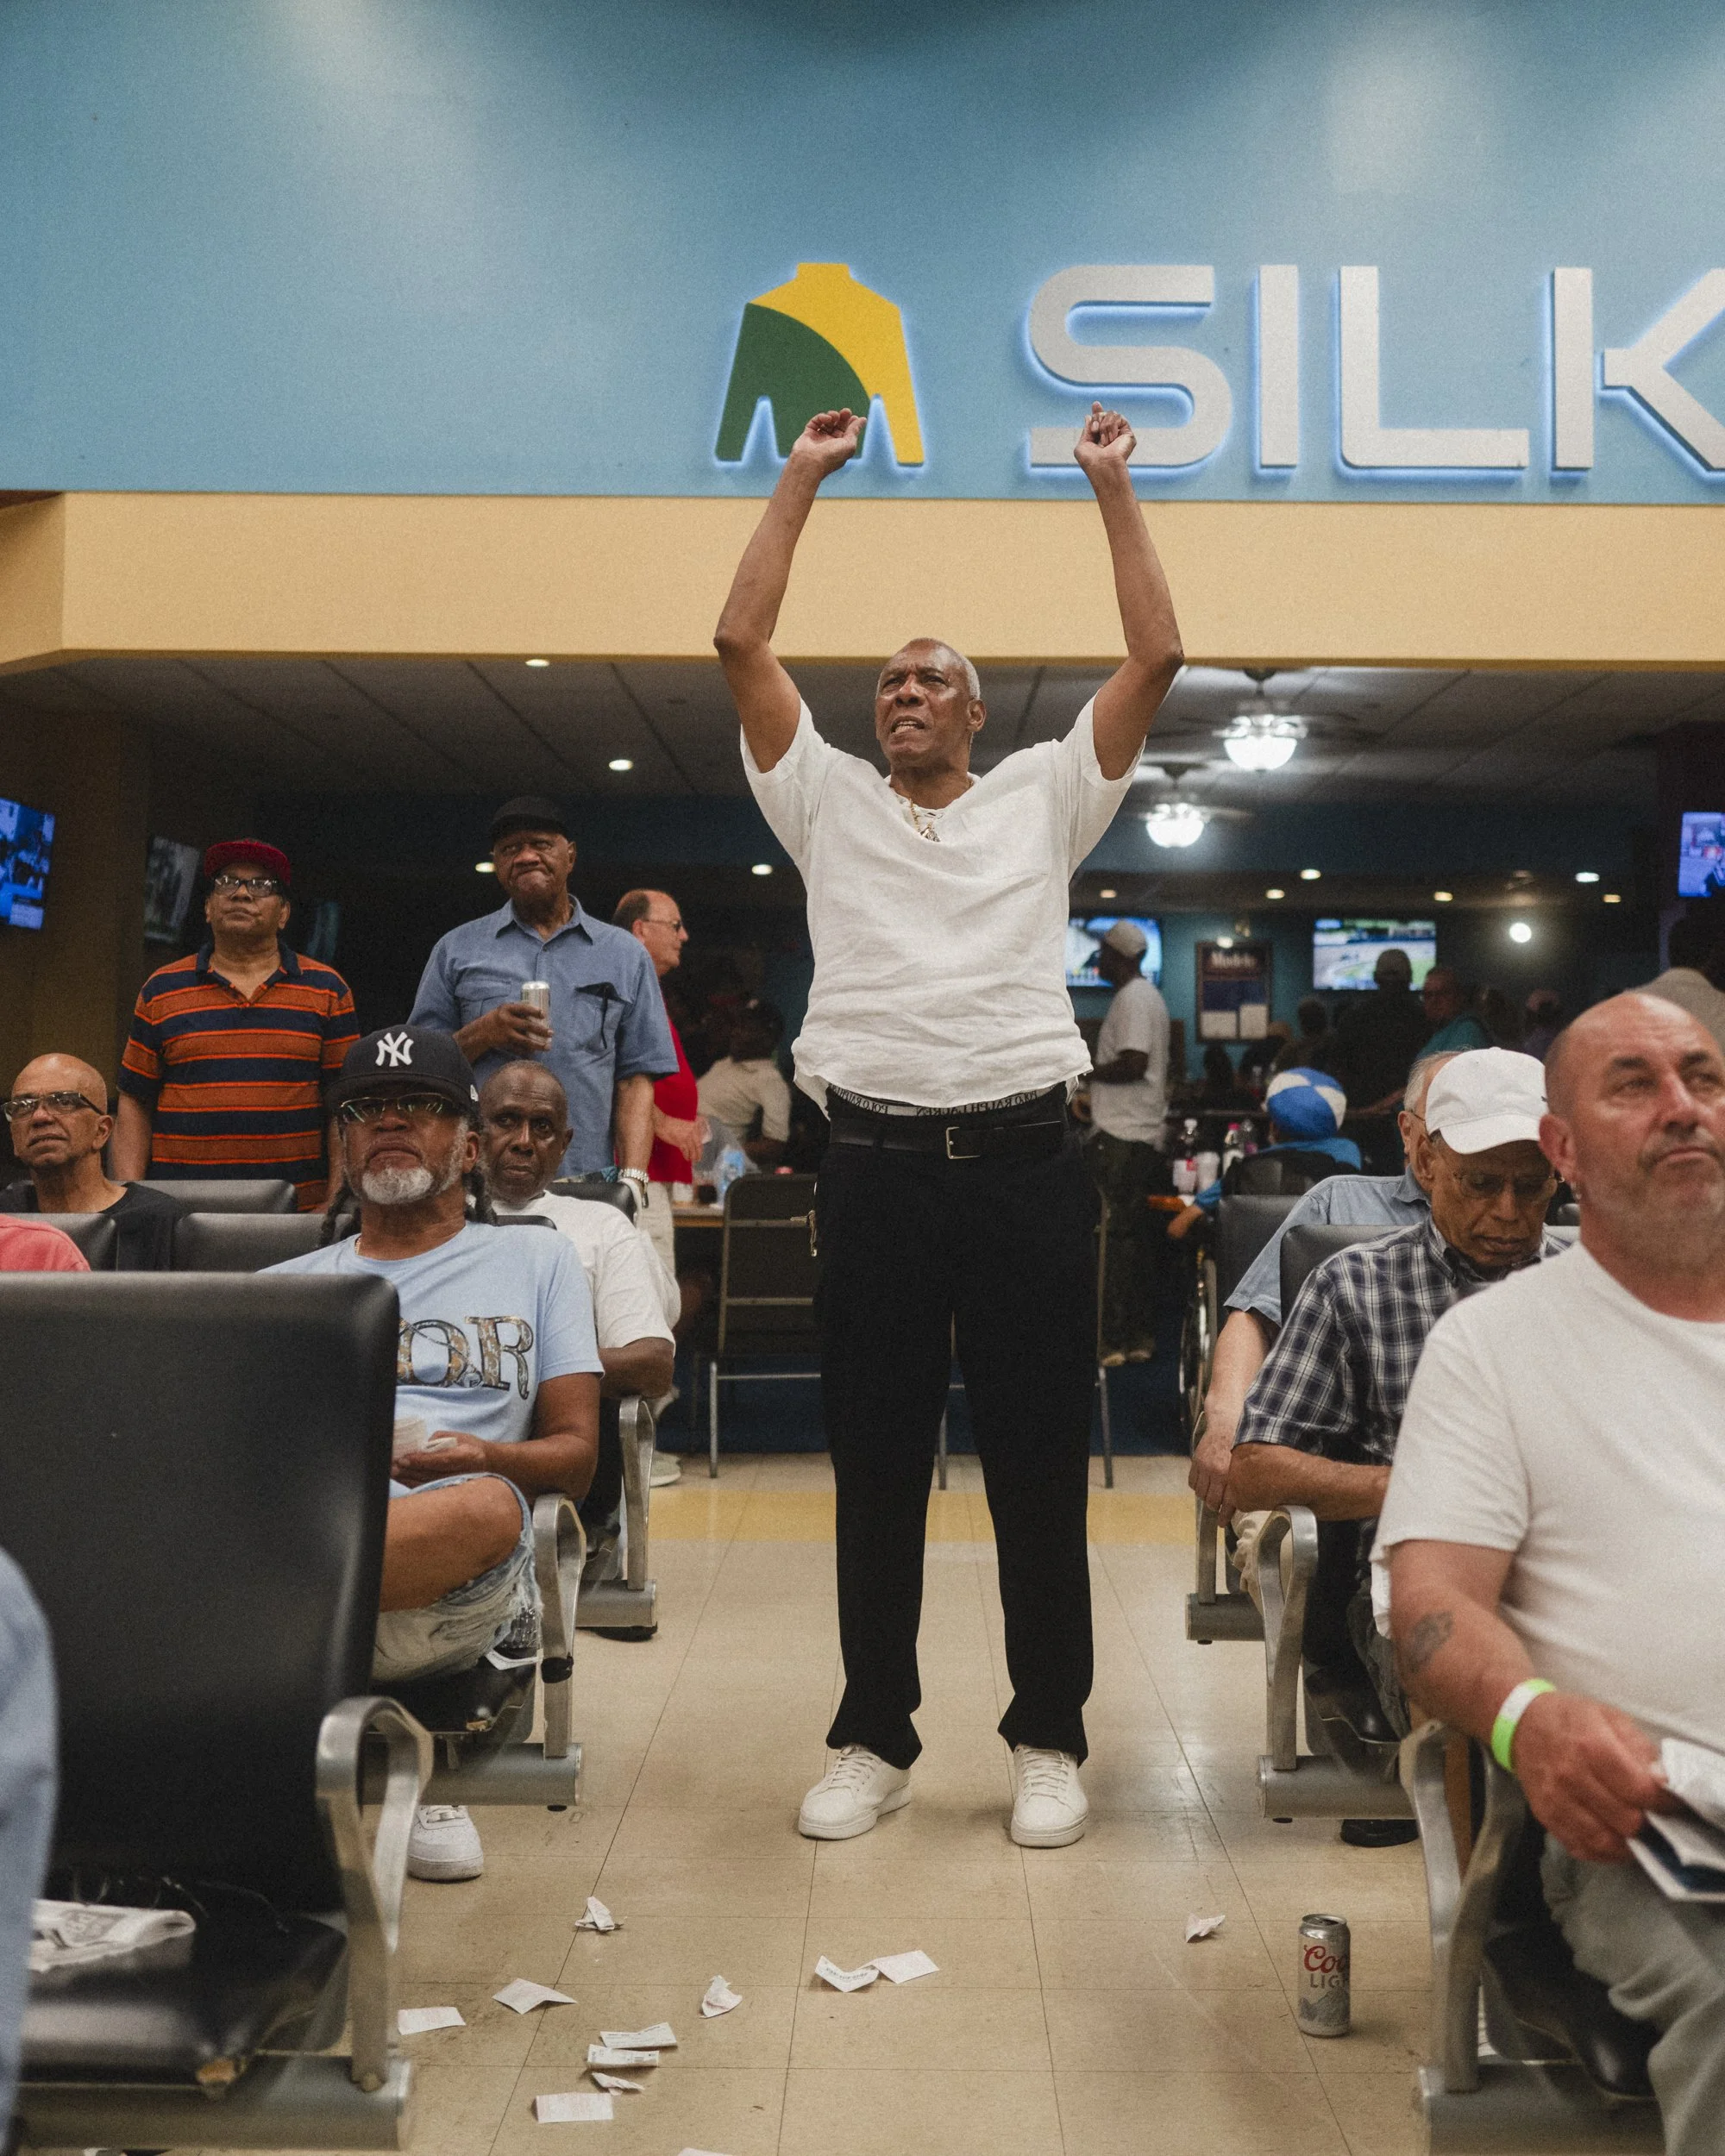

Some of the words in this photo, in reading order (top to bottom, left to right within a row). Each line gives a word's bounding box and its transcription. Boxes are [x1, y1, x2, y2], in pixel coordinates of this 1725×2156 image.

[1030, 264, 1725, 471] SILK
[375, 1031, 414, 1067] NY
[1310, 1973, 1346, 1989] LIG
